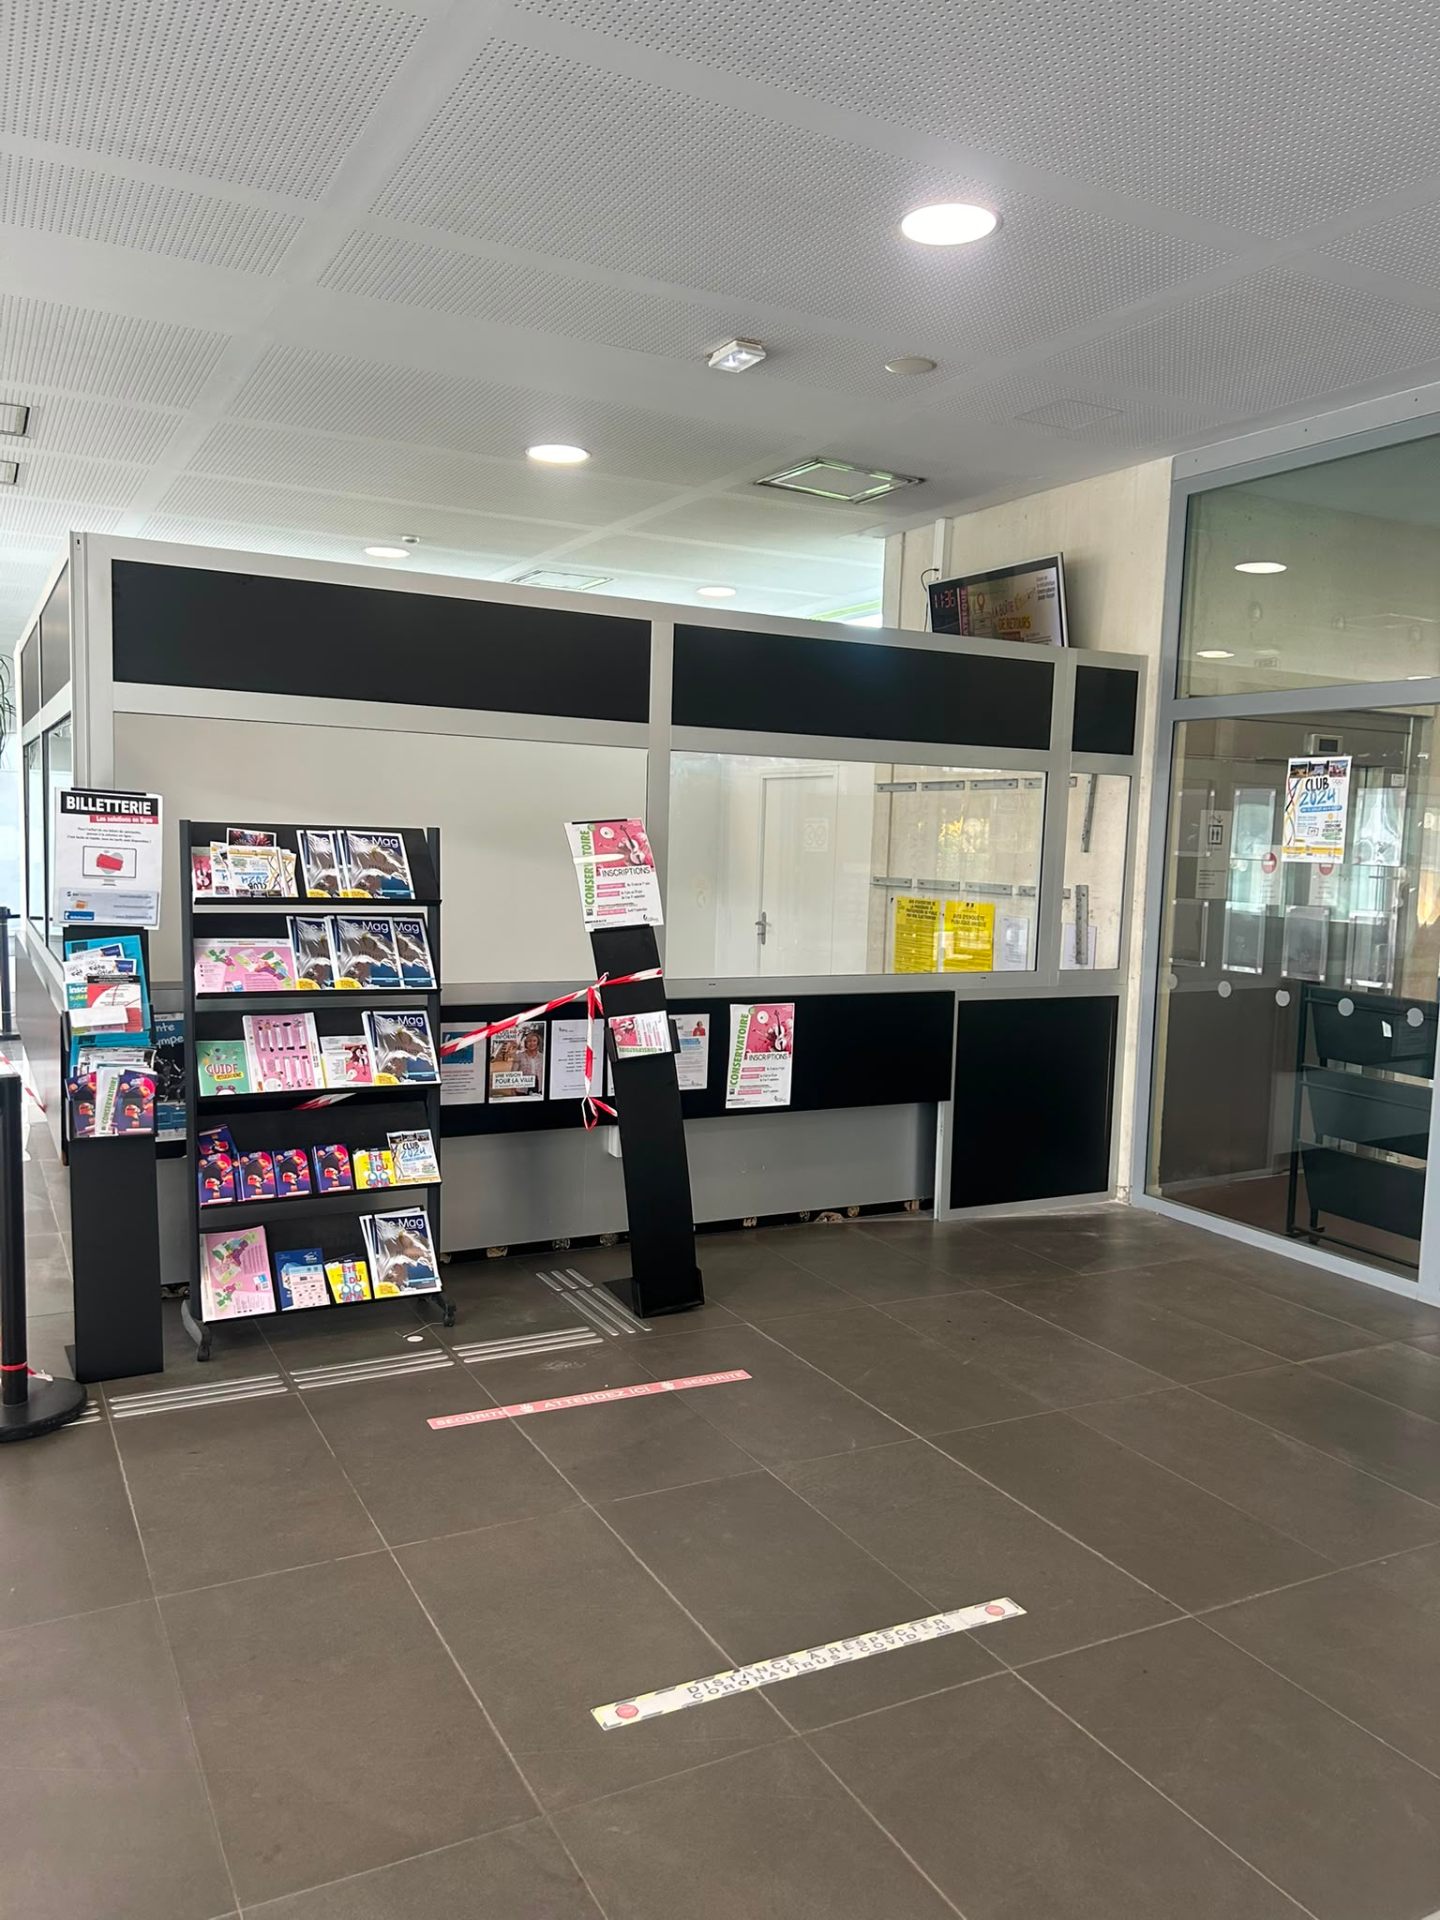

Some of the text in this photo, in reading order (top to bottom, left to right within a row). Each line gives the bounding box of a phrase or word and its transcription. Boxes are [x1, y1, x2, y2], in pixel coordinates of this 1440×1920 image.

[1305, 777, 1330, 792] CLUB
[1299, 790, 1336, 807] 2024
[66, 796, 152, 815] BILLETTERIE
[96, 815, 108, 823] Les
[372, 836, 399, 848] Mag
[601, 866, 651, 878] INSCRIPTIONS
[362, 921, 389, 933] Mag
[398, 1015, 424, 1027] Mag
[730, 1013, 749, 1086] CONSERVATOIRE
[748, 1053, 787, 1061] INSCRIPTIONS
[206, 1062, 238, 1075] GUIDE
[402, 1141, 420, 1150] CLUB
[401, 1147, 426, 1160] 2024
[376, 1163, 389, 1171] DU
[398, 1217, 424, 1230] Mag
[349, 1274, 362, 1284] DU
[544, 1390, 625, 1409] ATTENDEZ
[687, 1657, 799, 1694] DISTANCE
[828, 1618, 947, 1655] RESPECTER
[692, 1654, 842, 1699] CORONAVIRUS
[860, 1633, 918, 1653] COVID
[937, 1624, 951, 1633] 19
